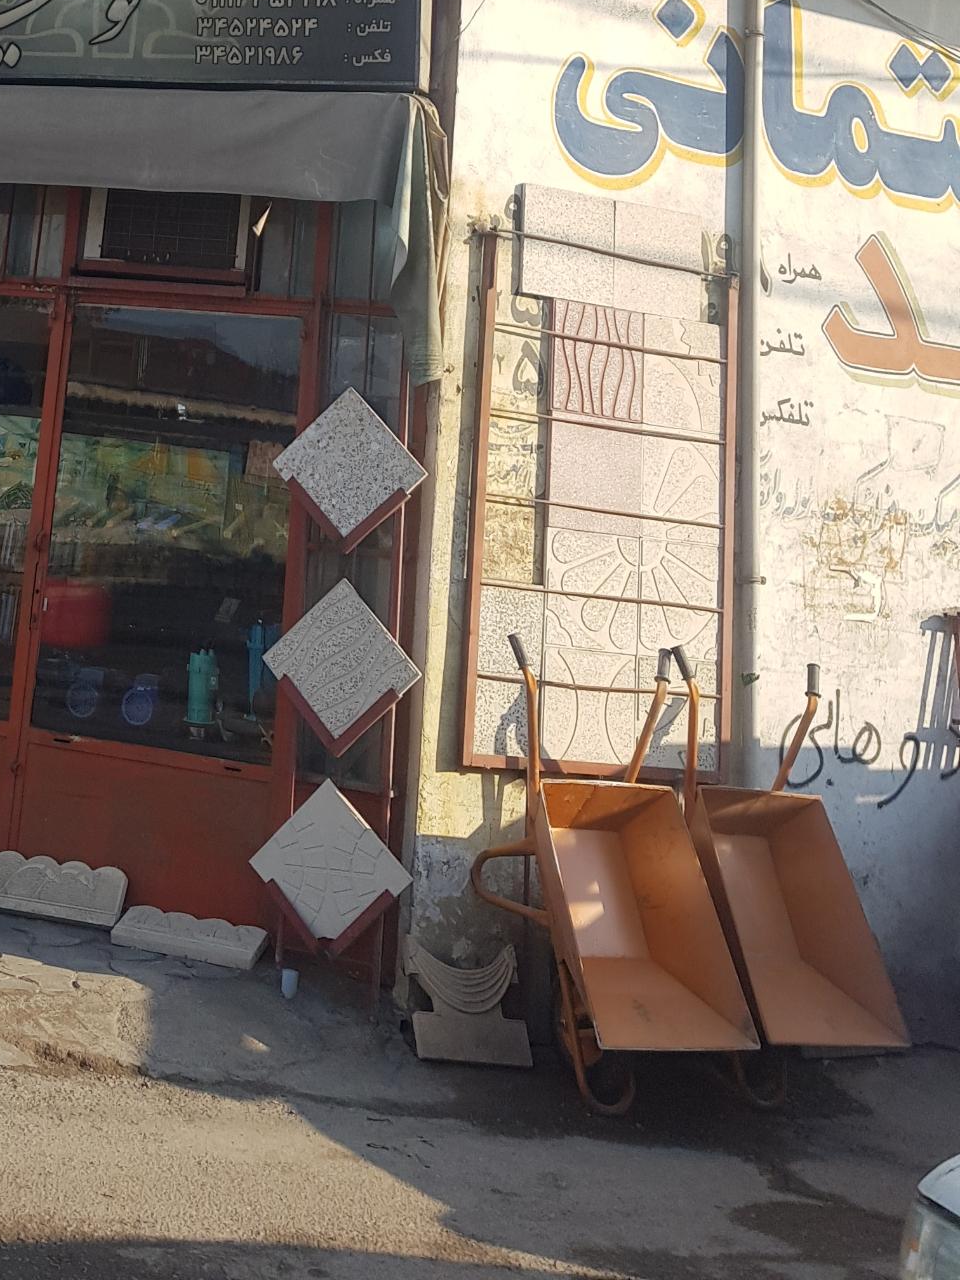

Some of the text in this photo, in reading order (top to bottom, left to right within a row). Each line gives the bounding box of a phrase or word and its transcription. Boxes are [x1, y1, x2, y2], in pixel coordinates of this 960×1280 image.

[197, 17, 318, 37] ۳۴۵۲۴۵۲۴
[195, 45, 304, 65] ۳۴۵۲۱۹۸۶
[778, 253, 822, 283] همراه
